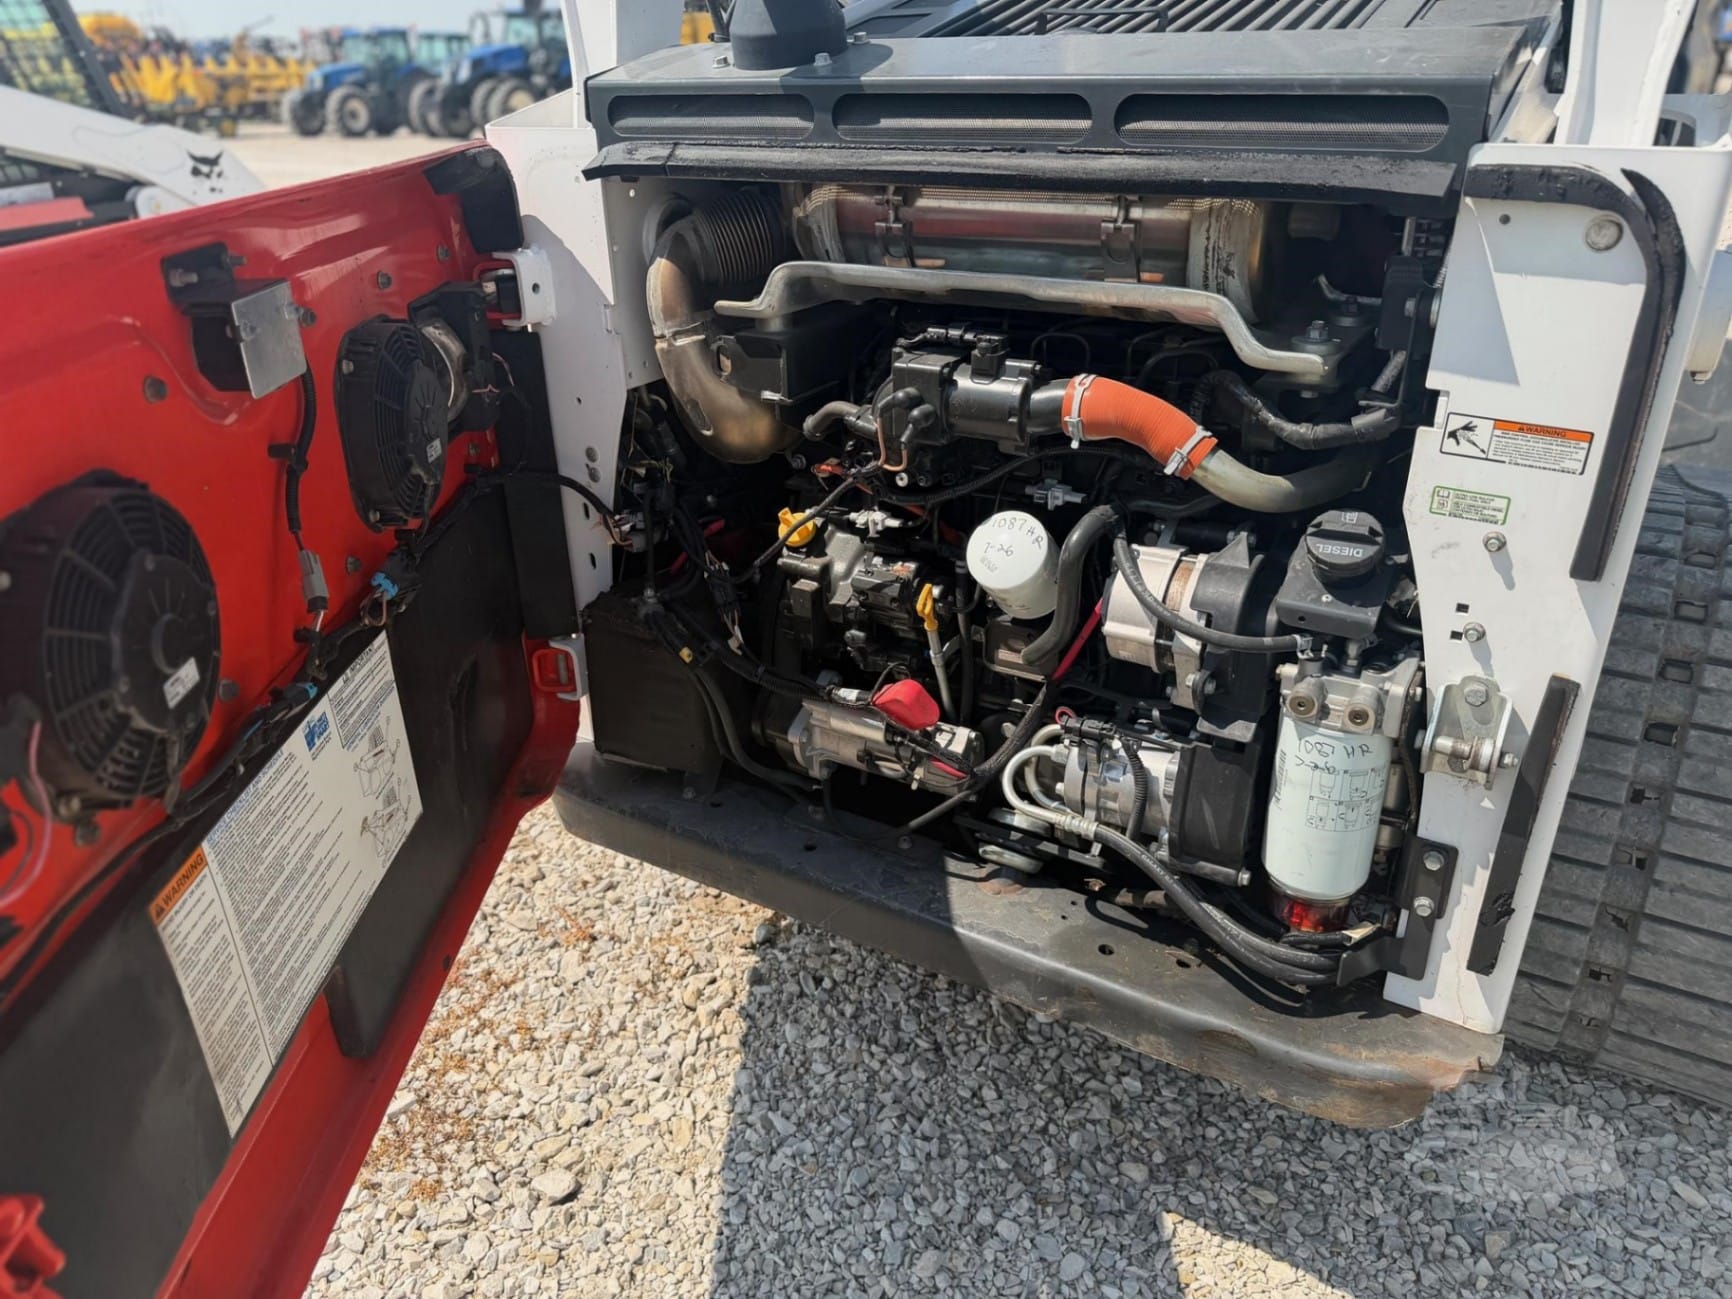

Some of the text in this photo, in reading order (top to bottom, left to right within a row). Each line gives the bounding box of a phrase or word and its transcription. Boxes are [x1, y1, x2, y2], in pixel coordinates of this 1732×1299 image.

[1526, 426, 1567, 438] WARNING
[992, 516, 1027, 531] 1087
[1316, 543, 1364, 557] DIESEL
[1298, 738, 1374, 759] 1087 HR
[162, 854, 204, 905] WARNING
